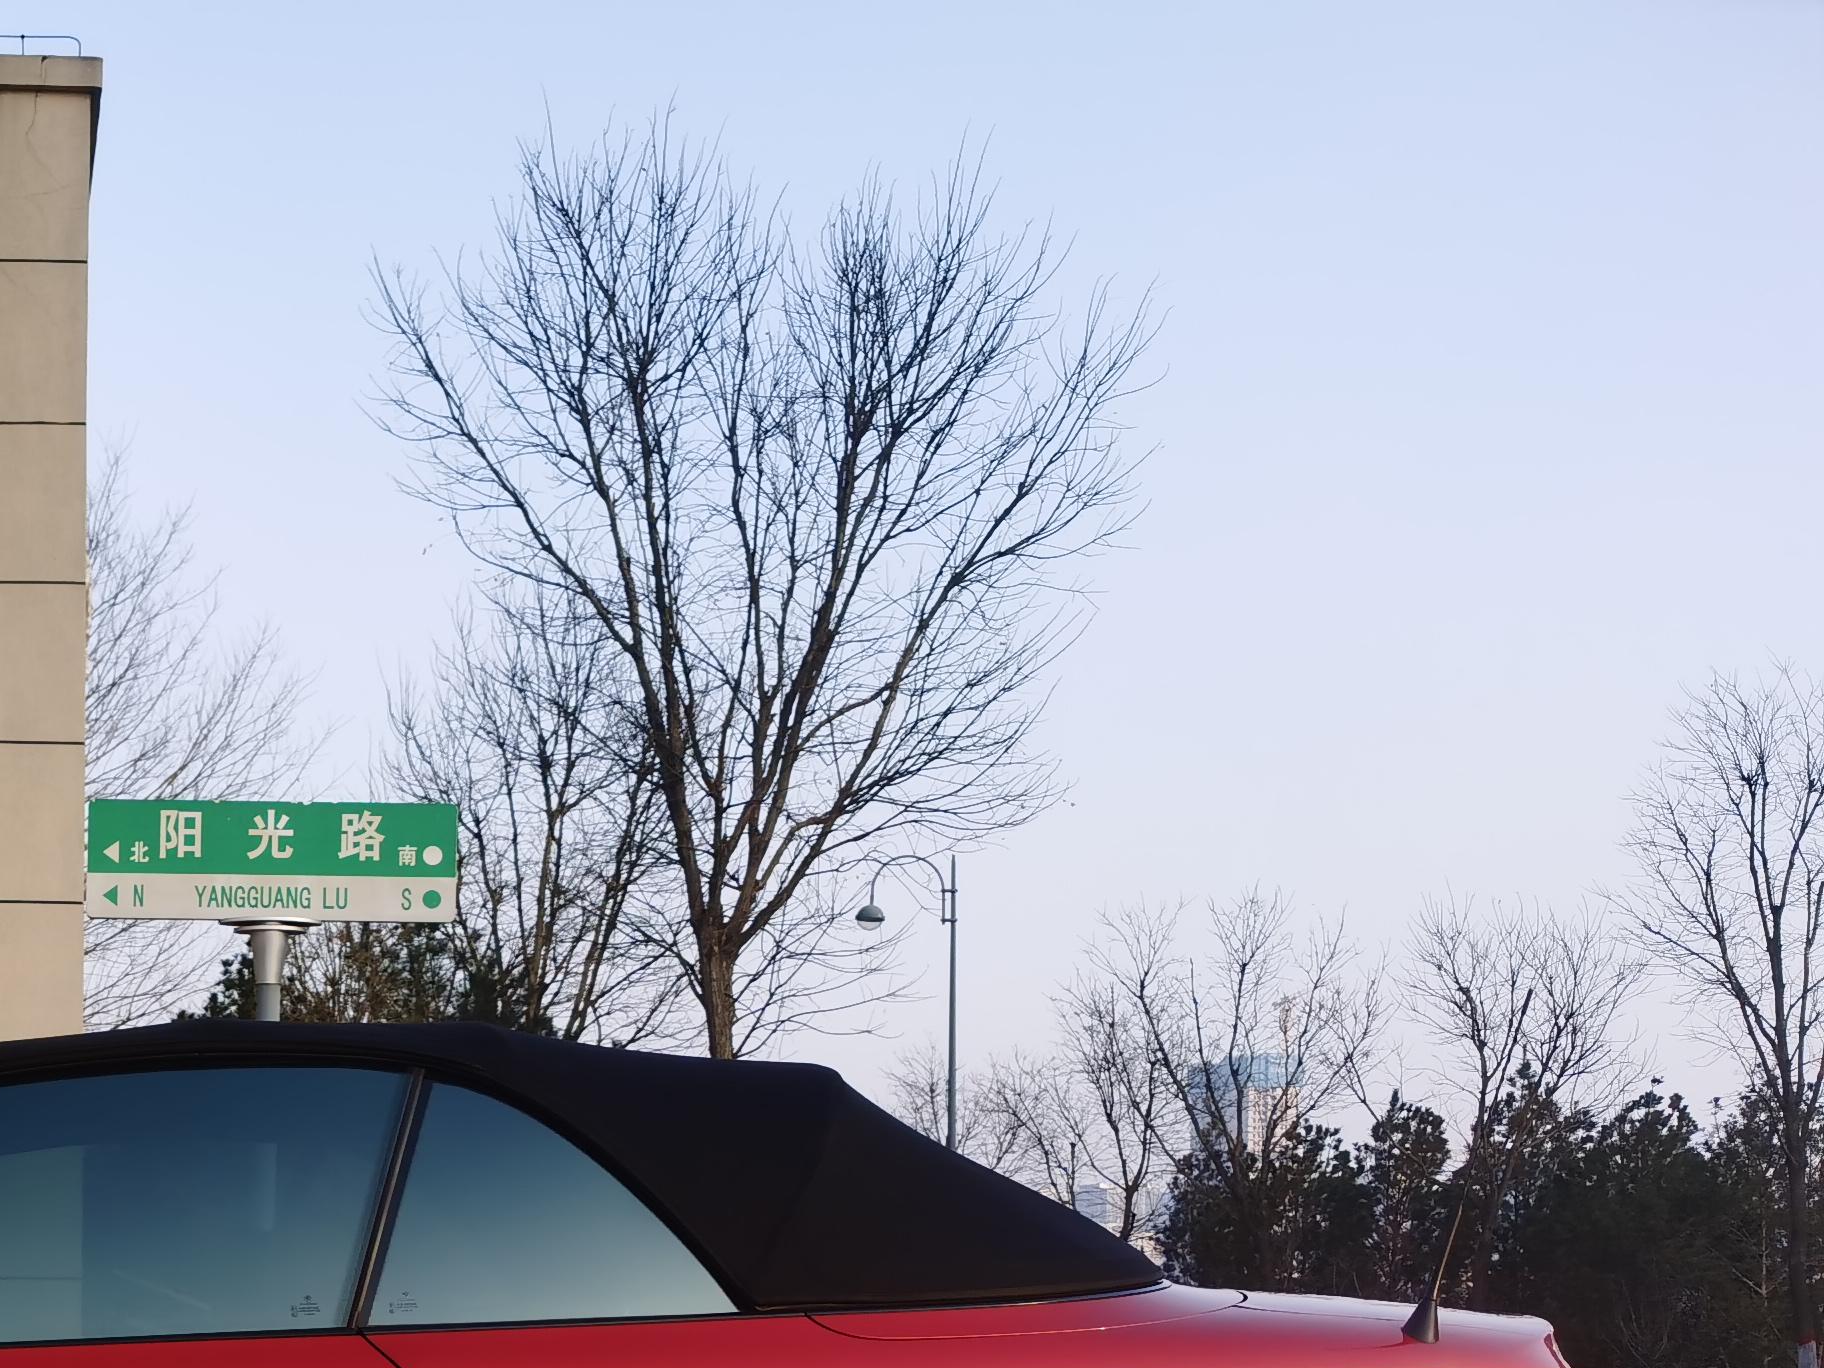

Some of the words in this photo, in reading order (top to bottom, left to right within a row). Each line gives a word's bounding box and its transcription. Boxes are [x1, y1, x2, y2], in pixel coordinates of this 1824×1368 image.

[129, 841, 149, 863] 北
[159, 809, 385, 862] 阳光路
[397, 844, 418, 867] 南
[133, 884, 144, 907] N
[194, 885, 311, 910] YANGGUANG
[322, 886, 349, 910] LU
[401, 887, 412, 911] S
